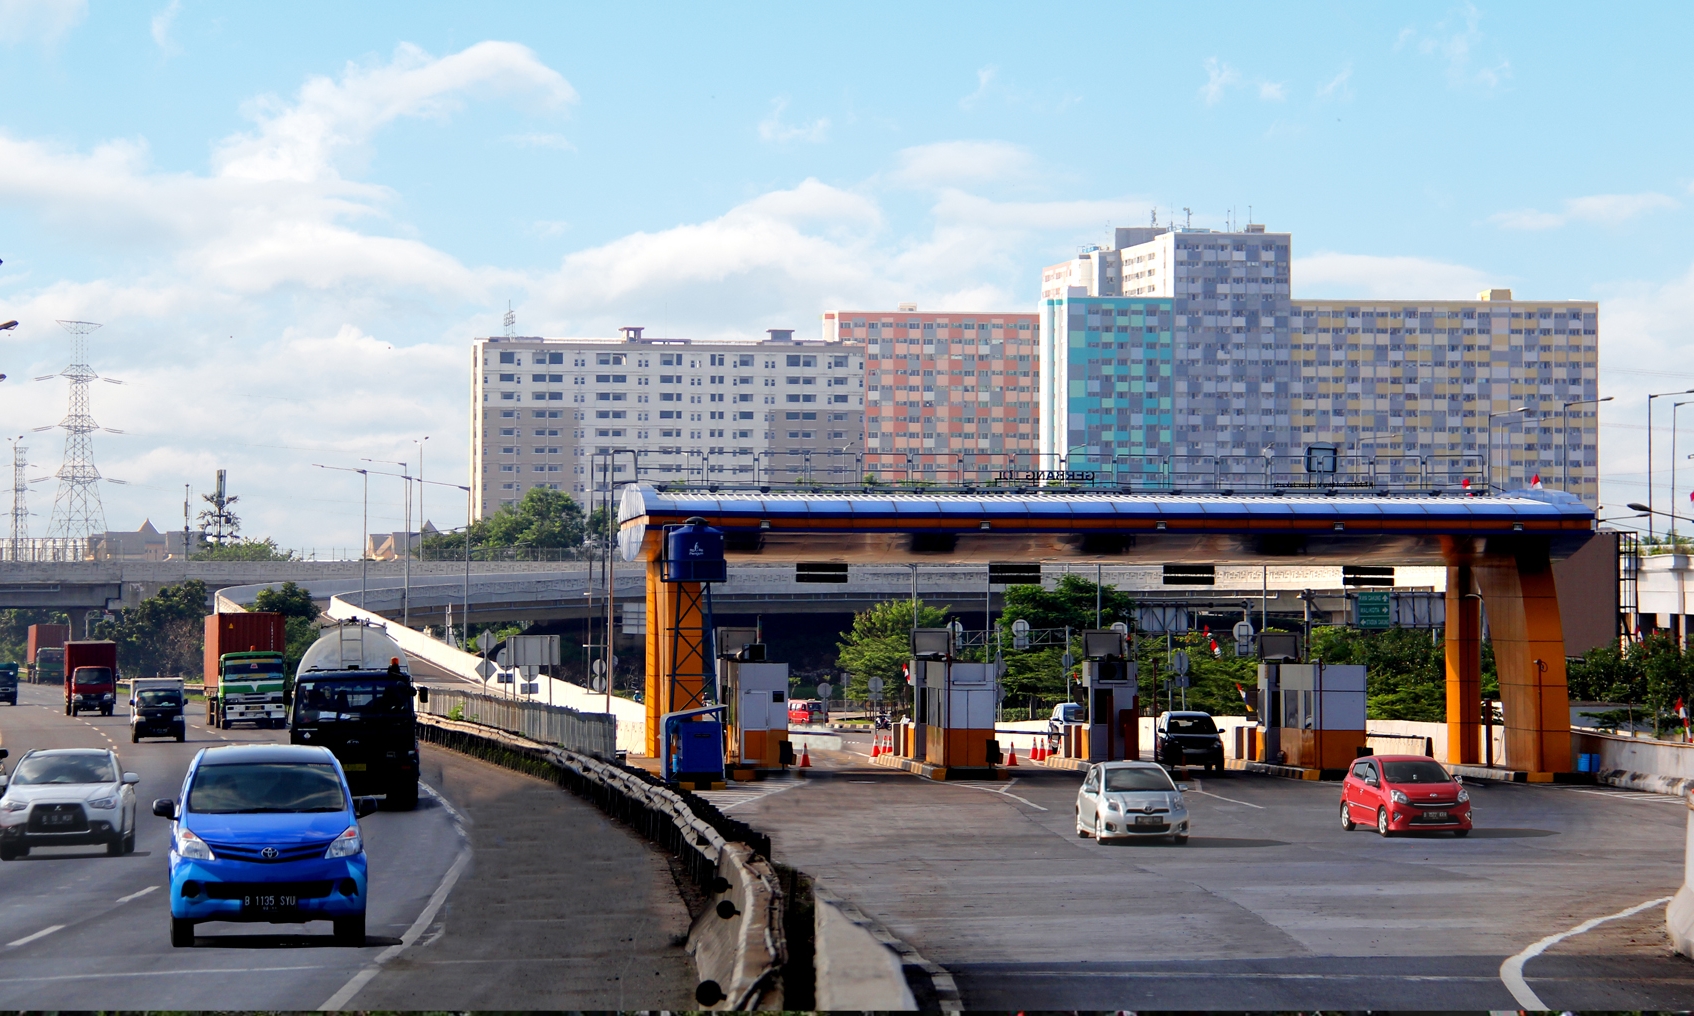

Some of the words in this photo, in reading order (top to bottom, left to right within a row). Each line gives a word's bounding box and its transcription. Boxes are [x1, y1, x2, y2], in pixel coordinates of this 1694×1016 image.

[244, 895, 250, 906] B
[255, 895, 275, 906] 1135
[280, 895, 296, 906] SYU
